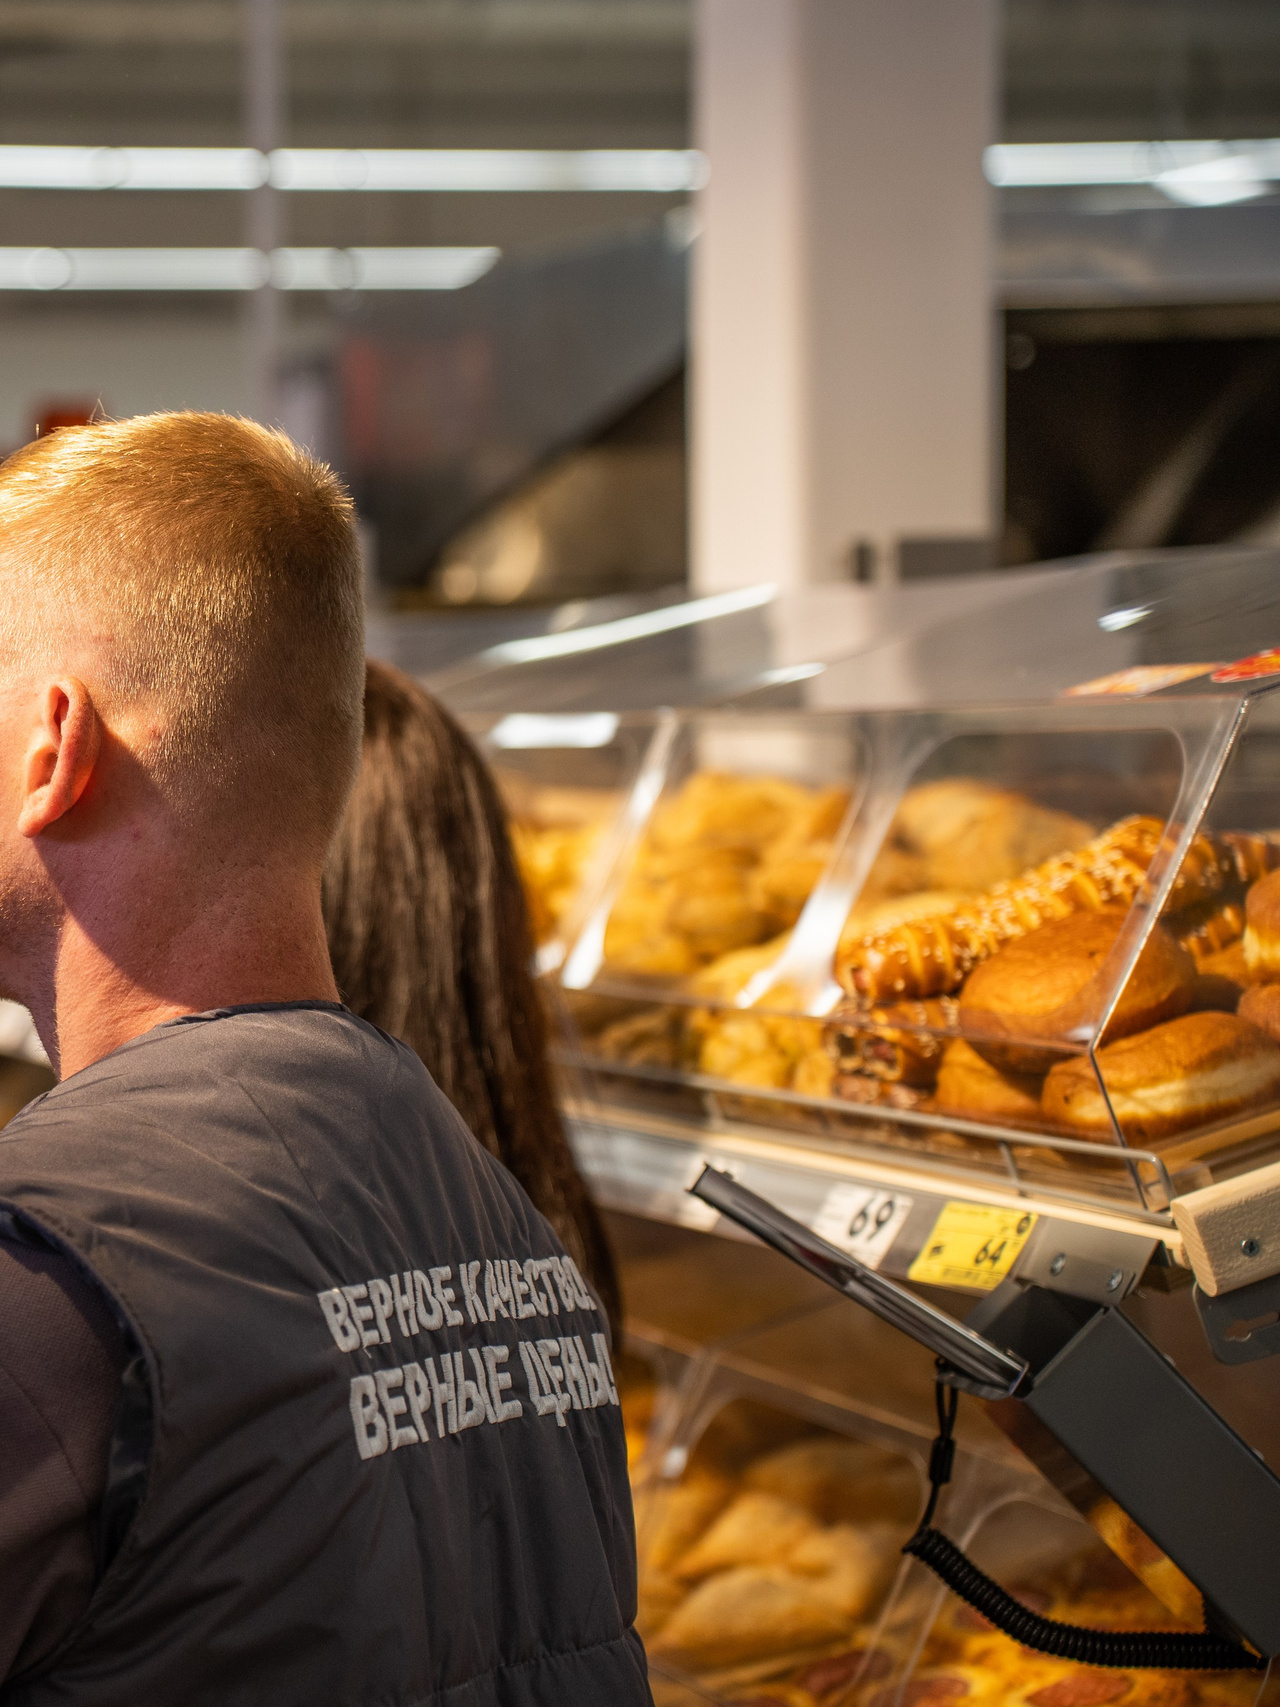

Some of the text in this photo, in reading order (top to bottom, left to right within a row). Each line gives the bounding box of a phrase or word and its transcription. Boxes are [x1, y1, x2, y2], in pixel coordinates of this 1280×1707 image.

[848, 1196, 895, 1242] 69
[975, 1239, 1007, 1267] 64
[318, 1266, 463, 1352] ВЕРНОЕ
[350, 1345, 523, 1460] ВЕРНЫЕ
